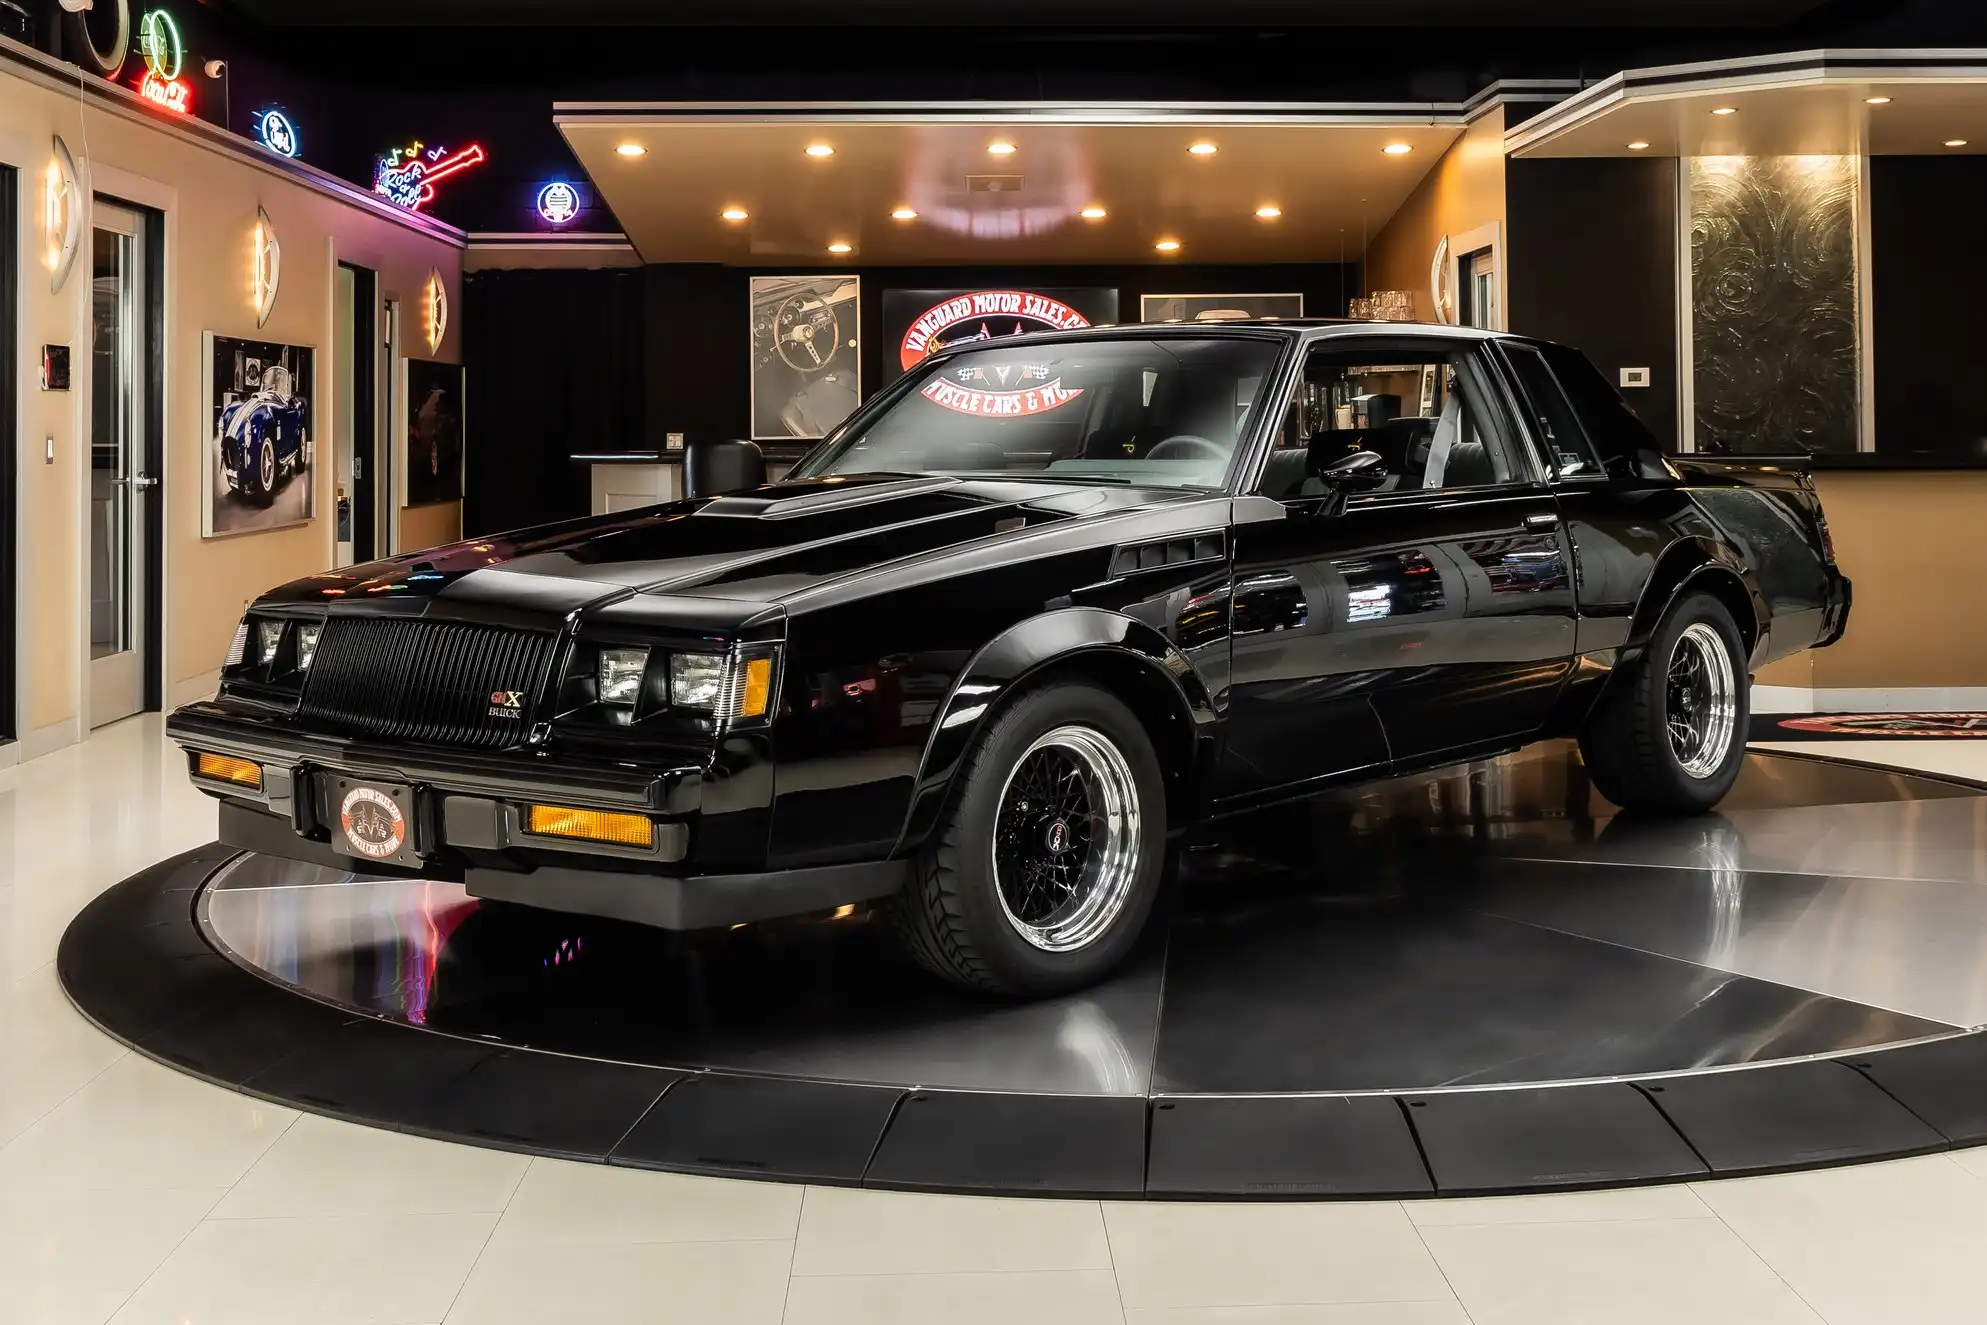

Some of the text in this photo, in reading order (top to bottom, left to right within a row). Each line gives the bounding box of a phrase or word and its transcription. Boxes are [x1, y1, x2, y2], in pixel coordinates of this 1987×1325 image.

[387, 164, 421, 188] Rock
[906, 298, 972, 352] VANGUARD
[973, 293, 1022, 314] MOTOR
[982, 394, 1022, 414] CARS
[1025, 392, 1039, 411] &
[488, 706, 522, 719] BUICK
